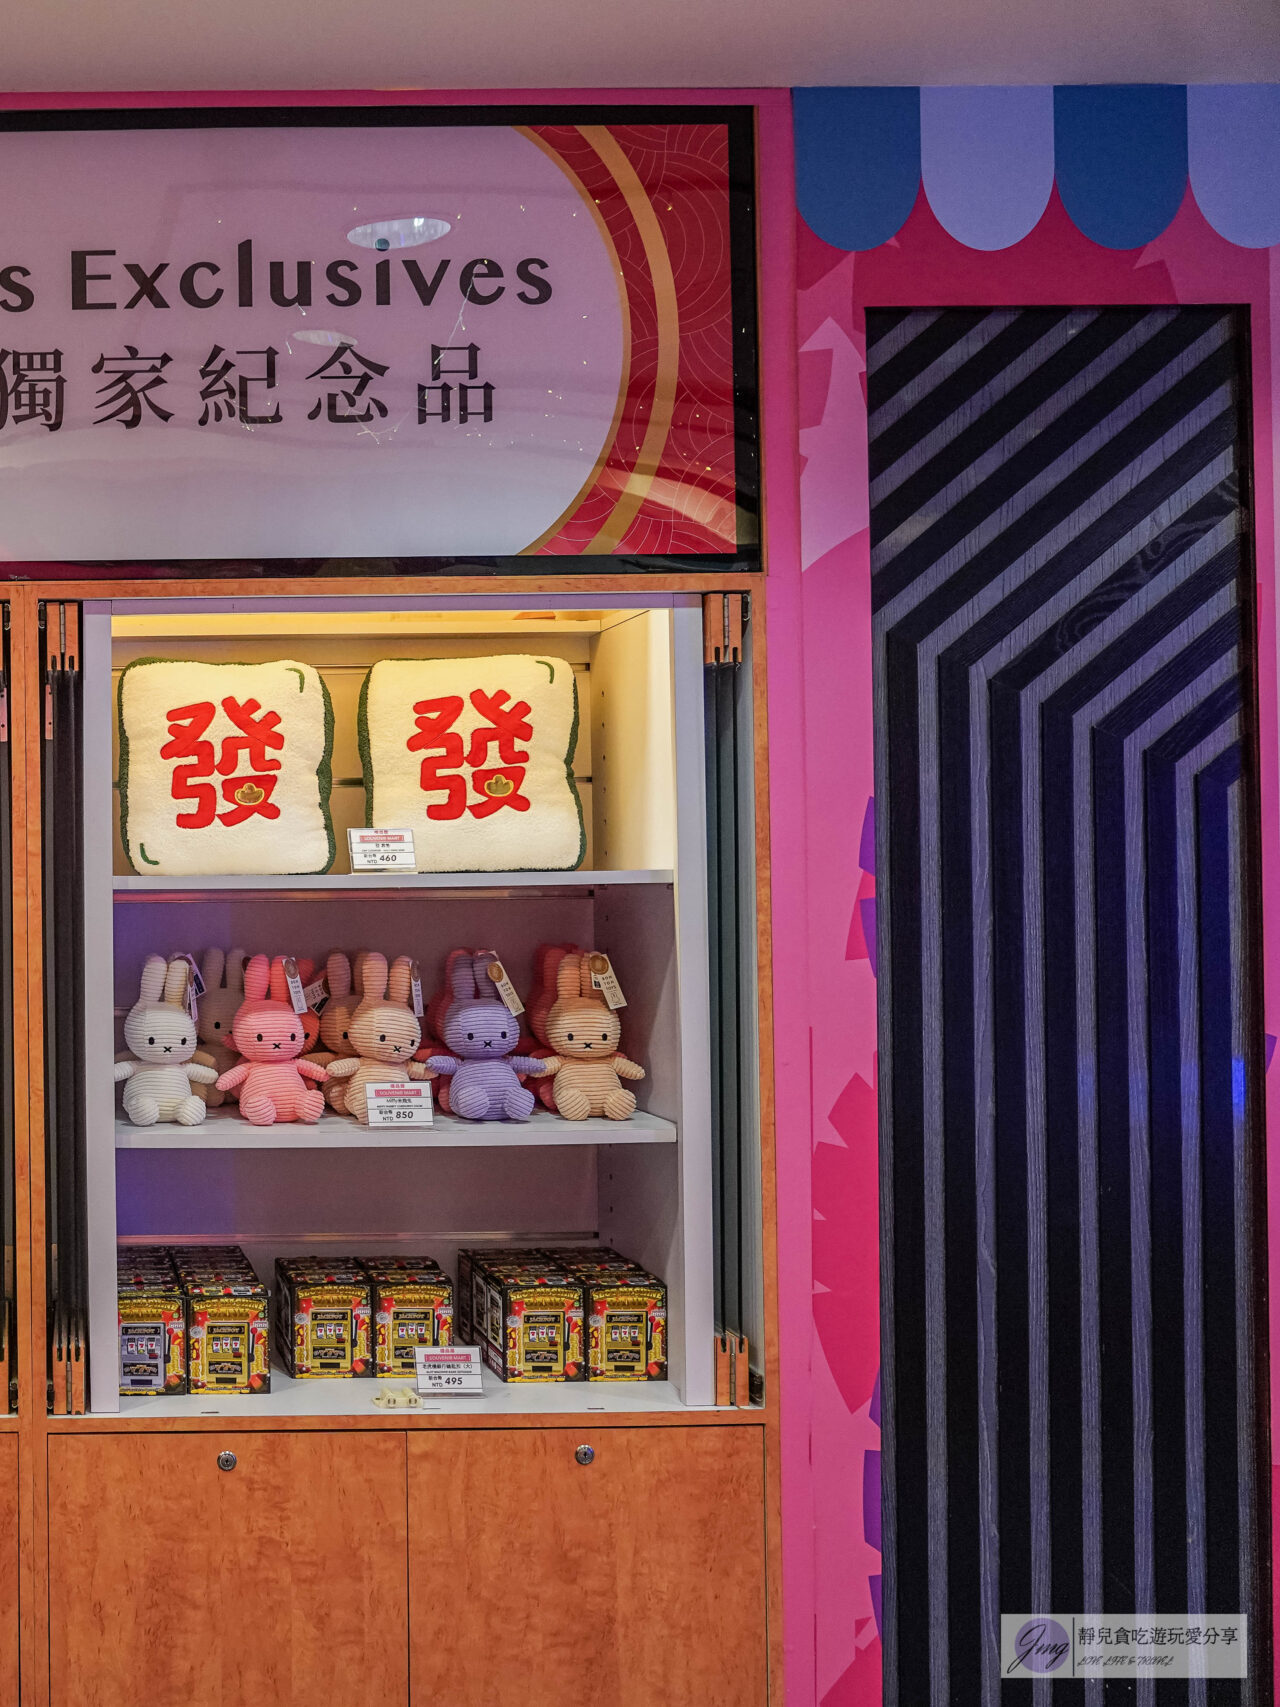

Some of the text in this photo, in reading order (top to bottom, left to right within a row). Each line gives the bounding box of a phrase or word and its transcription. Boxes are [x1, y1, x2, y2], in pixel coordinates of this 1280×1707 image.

[69, 238, 554, 310] Exclusives
[160, 696, 285, 830] 發
[406, 688, 534, 822] 發
